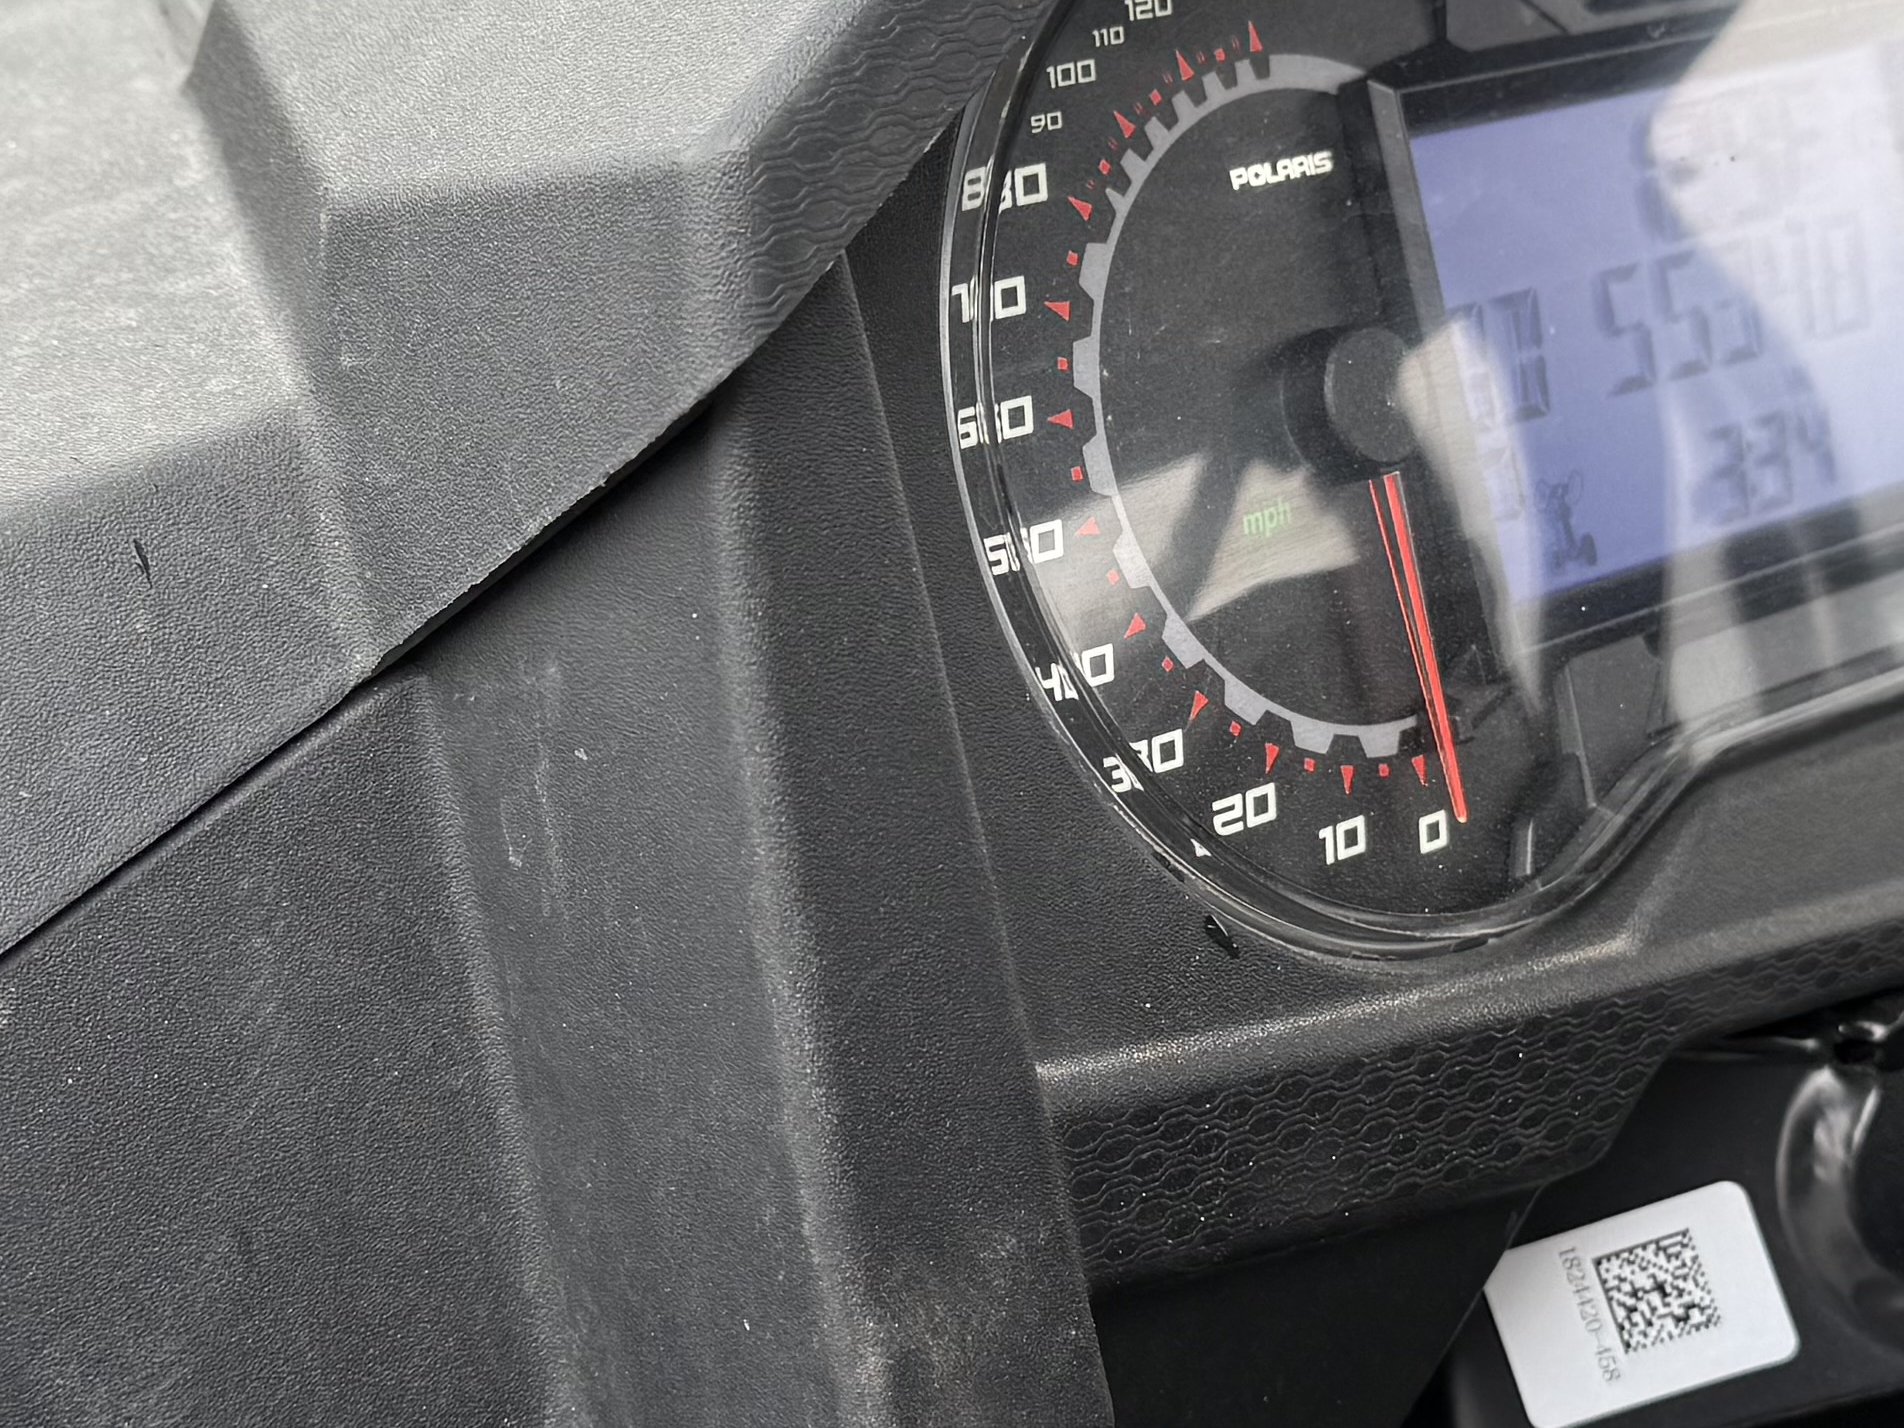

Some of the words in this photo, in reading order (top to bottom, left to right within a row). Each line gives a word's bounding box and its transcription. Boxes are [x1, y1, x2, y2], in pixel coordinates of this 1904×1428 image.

[1092, 25, 1125, 48] 110
[1046, 58, 1096, 89] 100
[1030, 111, 1063, 134] 90
[1229, 150, 1334, 190] POLARIS
[1242, 500, 1293, 538] mph
[1212, 782, 1277, 836] 20
[1318, 815, 1367, 865] 10
[1418, 810, 1448, 855] 0
